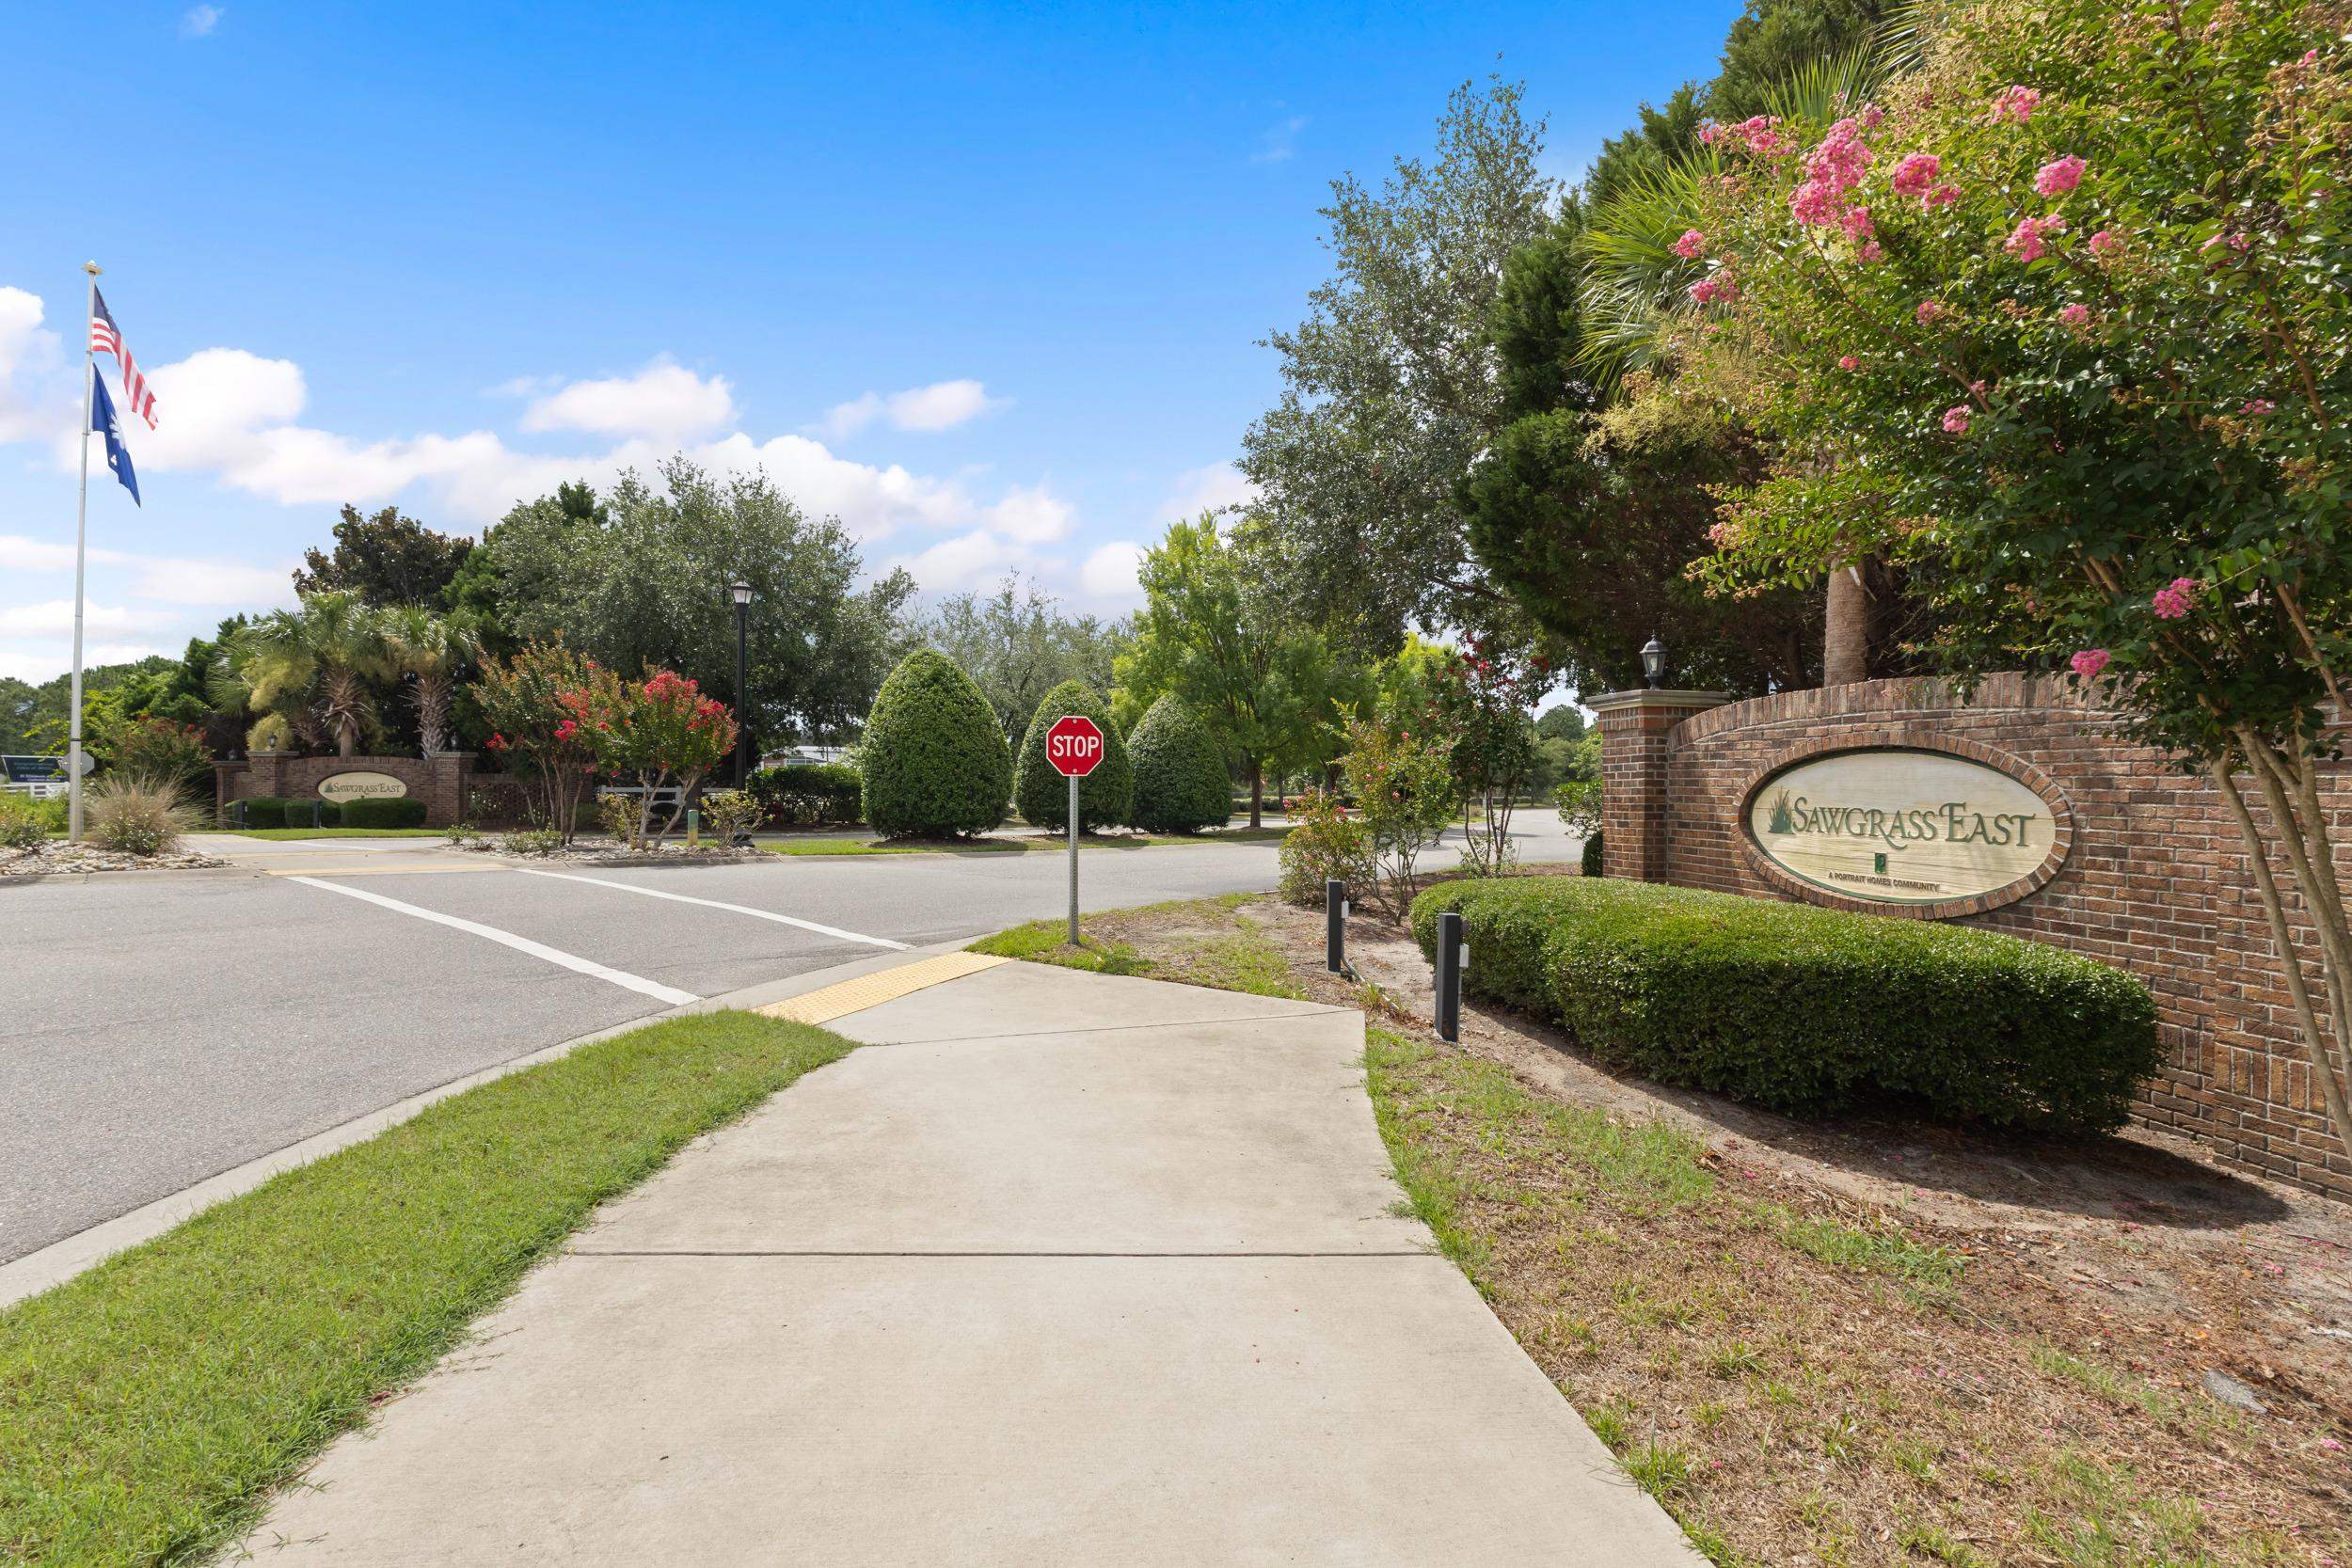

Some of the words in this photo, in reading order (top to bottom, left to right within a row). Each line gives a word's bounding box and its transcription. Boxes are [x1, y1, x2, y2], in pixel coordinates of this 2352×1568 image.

[1052, 735, 1100, 757] STOP
[333, 783, 378, 795] SAWGRASS
[378, 783, 401, 793] EAST
[1792, 796, 1938, 850] SAWGRASS
[1938, 801, 2037, 847] EAST
[1828, 871, 1834, 879] A
[1835, 873, 1866, 884] PORTRAIT
[1867, 876, 1892, 887] HOMES
[1893, 879, 1941, 893] COMMUNITY
